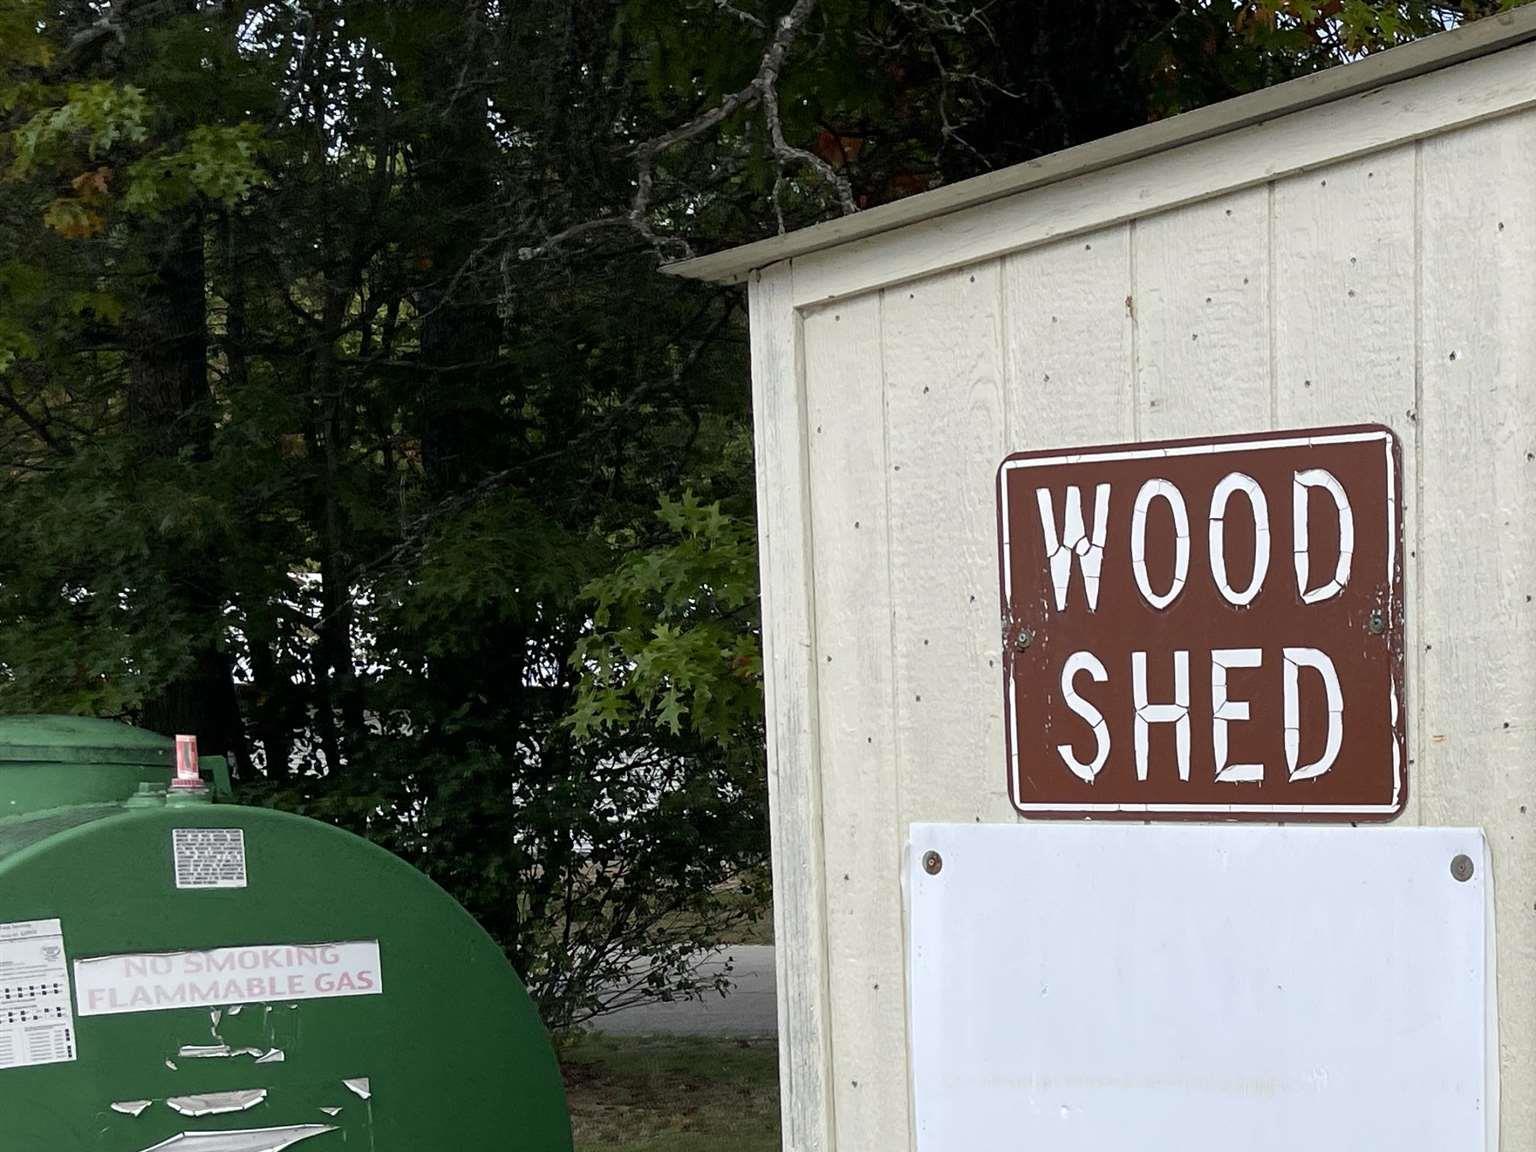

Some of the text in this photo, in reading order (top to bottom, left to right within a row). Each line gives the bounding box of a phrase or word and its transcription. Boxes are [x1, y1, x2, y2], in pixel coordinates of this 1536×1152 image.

[1036, 469, 1354, 613] WOOD
[1057, 647, 1344, 785] SHED
[88, 975, 305, 1010] FLAMMABLE
[315, 970, 373, 993] GAS
[123, 946, 340, 979] NO SMOKING
